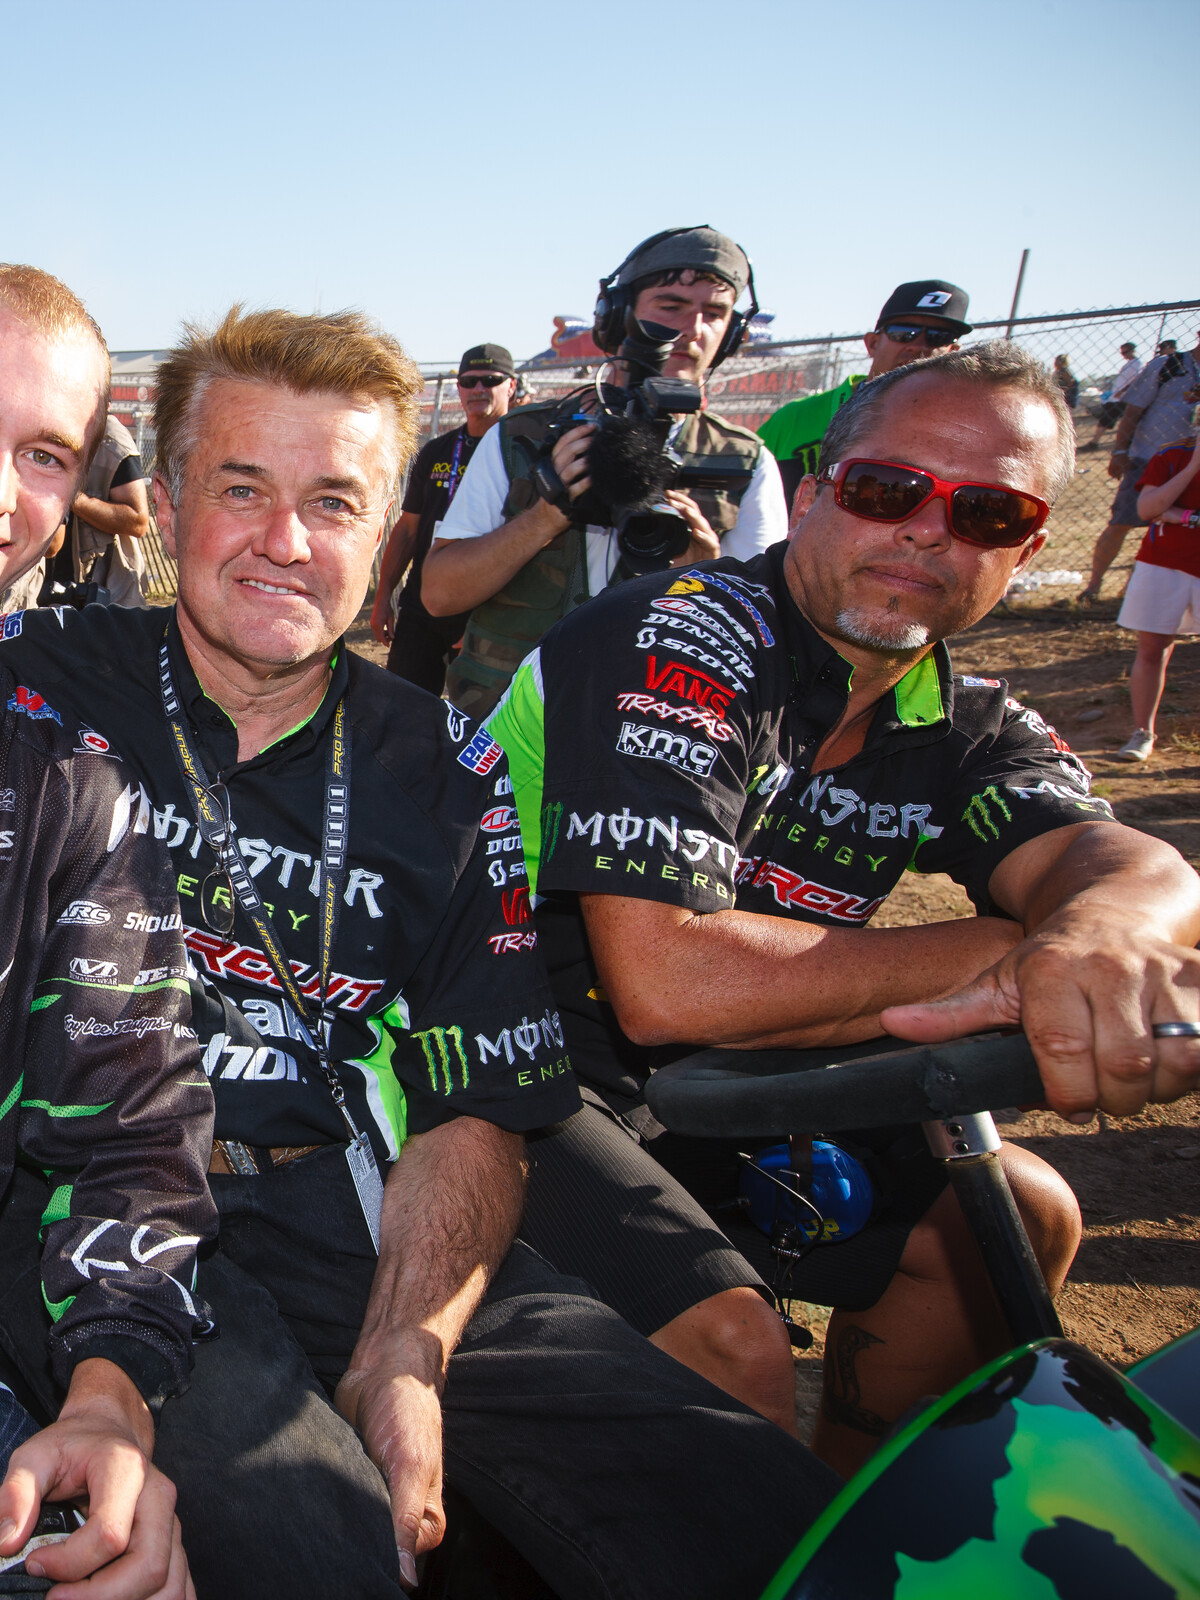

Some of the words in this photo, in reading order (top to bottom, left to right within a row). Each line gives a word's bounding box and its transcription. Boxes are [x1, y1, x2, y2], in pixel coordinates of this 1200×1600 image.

[642, 613, 756, 678] DUNLOP
[657, 637, 749, 694] SCOTT
[645, 655, 737, 721] VANS
[335, 697, 345, 738] CIRC
[617, 692, 735, 742] TRAXXAS
[333, 740, 344, 776] PRO
[621, 723, 715, 767] kmc
[623, 743, 704, 774] WHEELS
[566, 807, 739, 870] MONST
[595, 855, 736, 909] ENERG
[123, 911, 183, 933] SHOW
[323, 877, 336, 948] CIRCUIT
